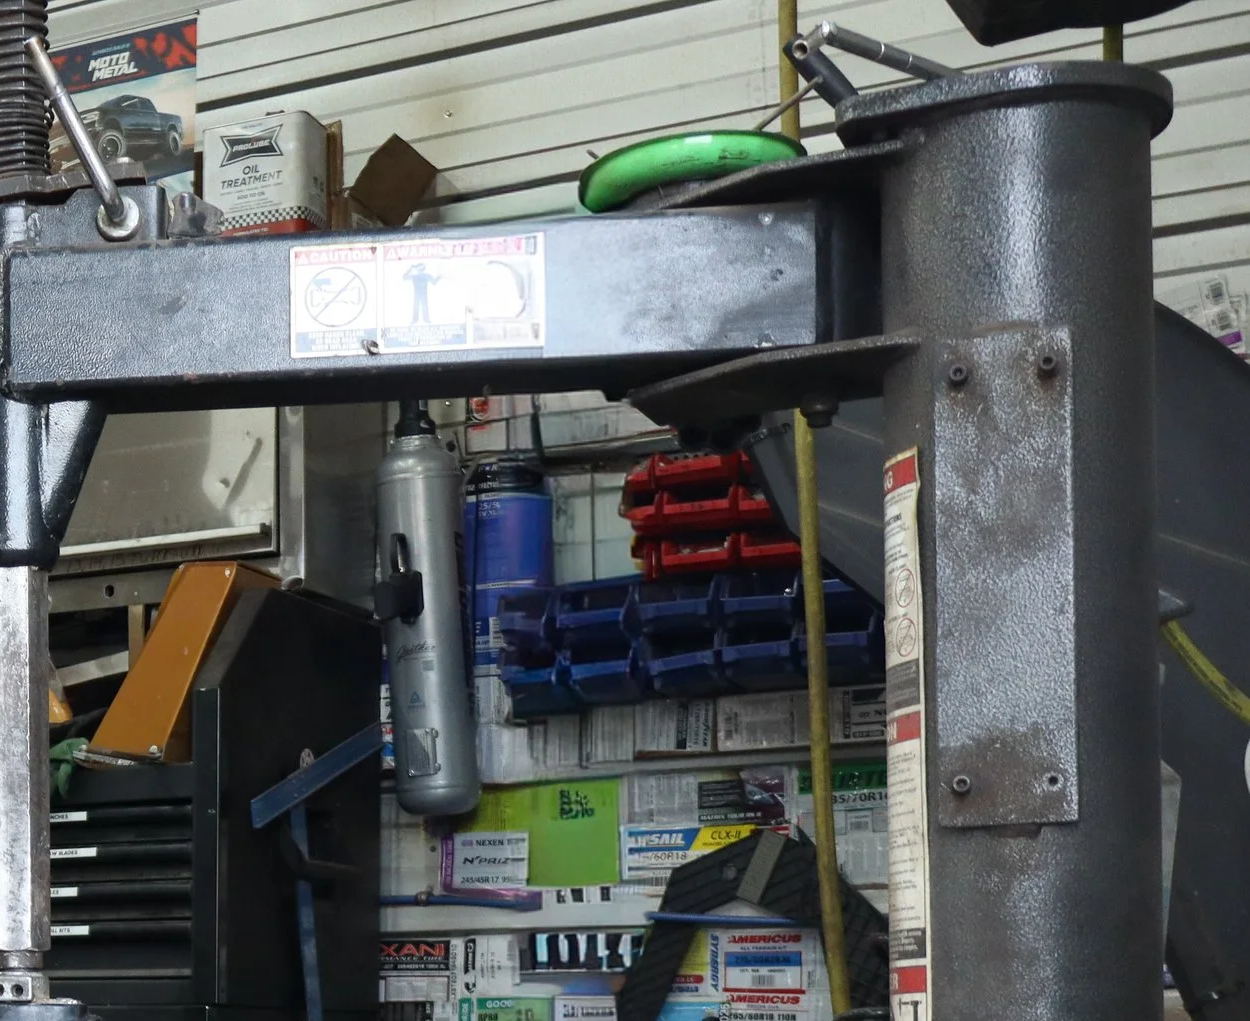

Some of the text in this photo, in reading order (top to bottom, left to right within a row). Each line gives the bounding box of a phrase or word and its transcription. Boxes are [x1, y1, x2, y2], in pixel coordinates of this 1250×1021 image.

[87, 52, 130, 71] MOTO
[92, 62, 138, 81] METAL
[233, 139, 270, 152] PROLUBE
[242, 164, 260, 176] OIL
[220, 170, 283, 190] TREATMENT
[310, 250, 373, 264] CAUTION
[475, 839, 503, 847] NEXEN
[727, 934, 802, 944] AMERICUS
[710, 933, 719, 992] SYNERGY
[726, 995, 801, 1005] AMERICUS
